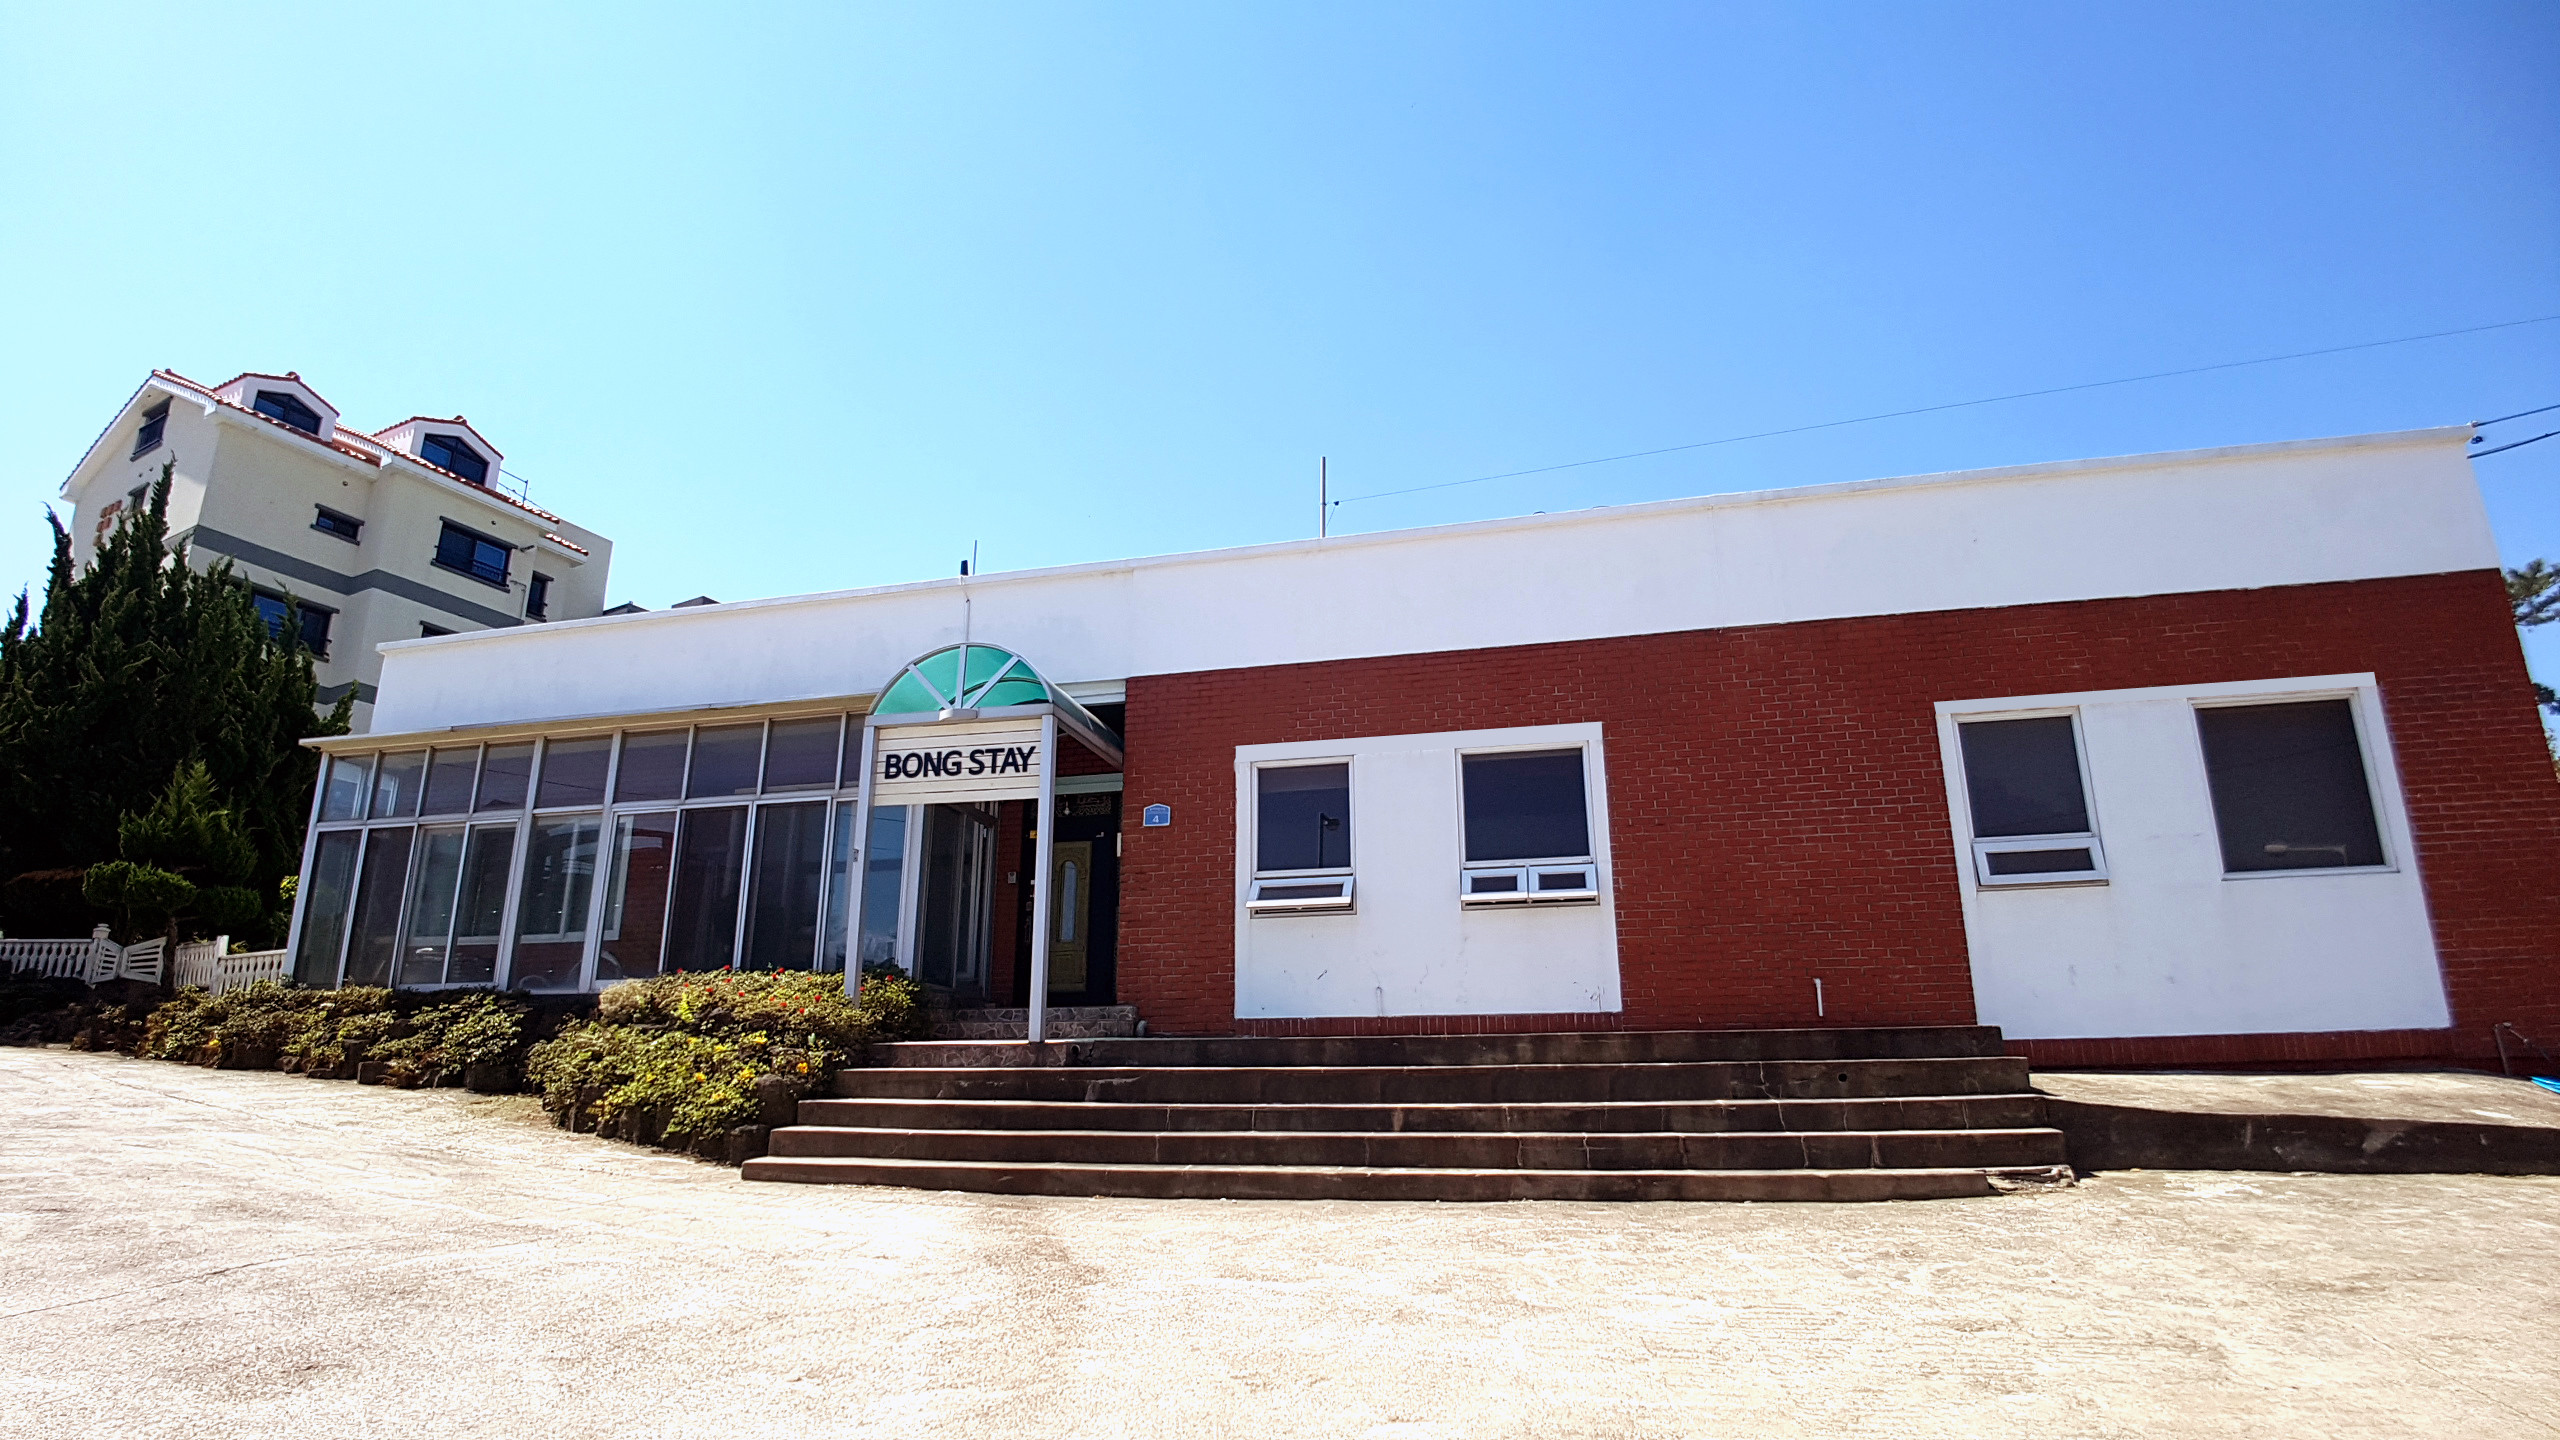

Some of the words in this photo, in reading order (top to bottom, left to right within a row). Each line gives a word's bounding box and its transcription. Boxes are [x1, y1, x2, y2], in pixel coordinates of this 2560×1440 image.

[885, 750, 963, 779] BONG
[968, 746, 1036, 775] STAY
[1152, 815, 1159, 823] 4
